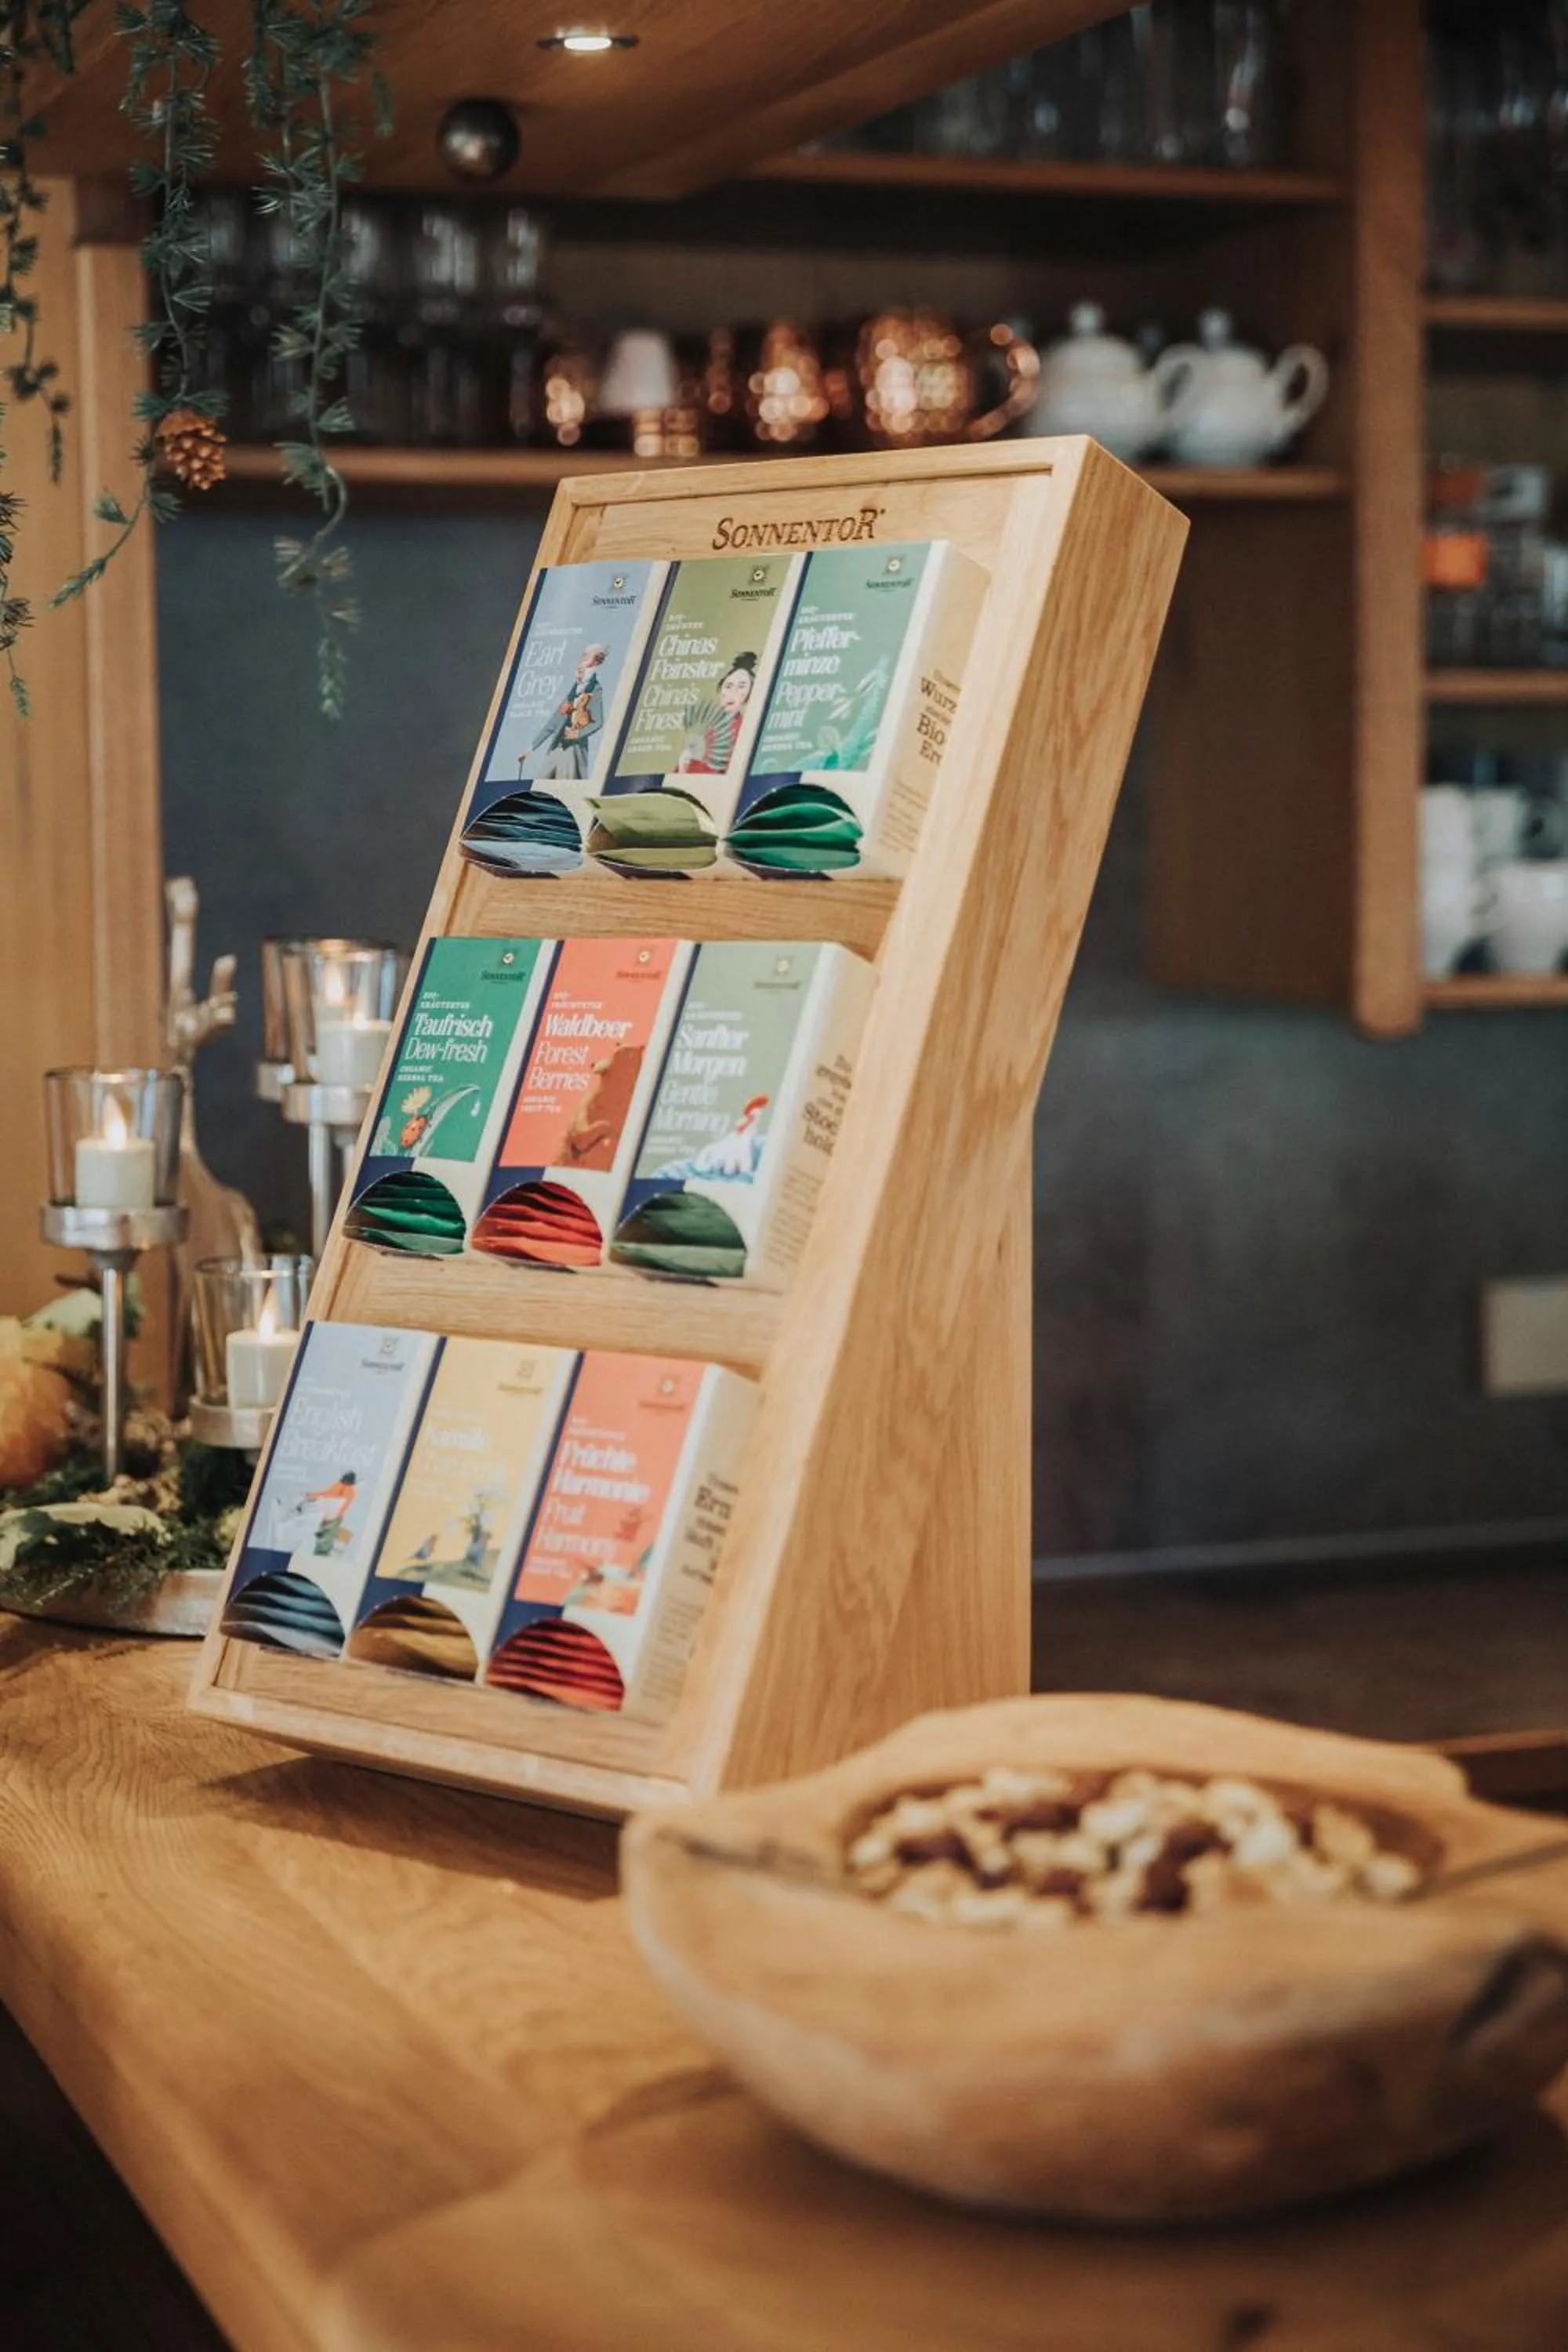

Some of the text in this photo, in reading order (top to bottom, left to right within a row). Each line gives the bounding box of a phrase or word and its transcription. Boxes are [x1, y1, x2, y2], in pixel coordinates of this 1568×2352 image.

[712, 508, 880, 550] SONNENTOR
[525, 639, 568, 666] Earl
[659, 634, 718, 657] Chinas
[651, 658, 725, 681] Feinster
[783, 652, 841, 677] minze
[517, 670, 565, 700] Grey
[643, 682, 700, 709] China's
[768, 708, 807, 731] mint
[413, 1012, 494, 1038] Taufrisch
[544, 1012, 633, 1039] Waldbeer
[675, 1022, 750, 1050] Sanfter
[404, 1037, 488, 1064] Dew-fresh
[535, 1040, 590, 1065] Forest
[527, 1065, 591, 1091] Berries
[670, 1050, 748, 1081] Morgen
[659, 1079, 720, 1106] Gentle
[655, 1105, 731, 1134] Morning
[290, 1396, 364, 1433] English
